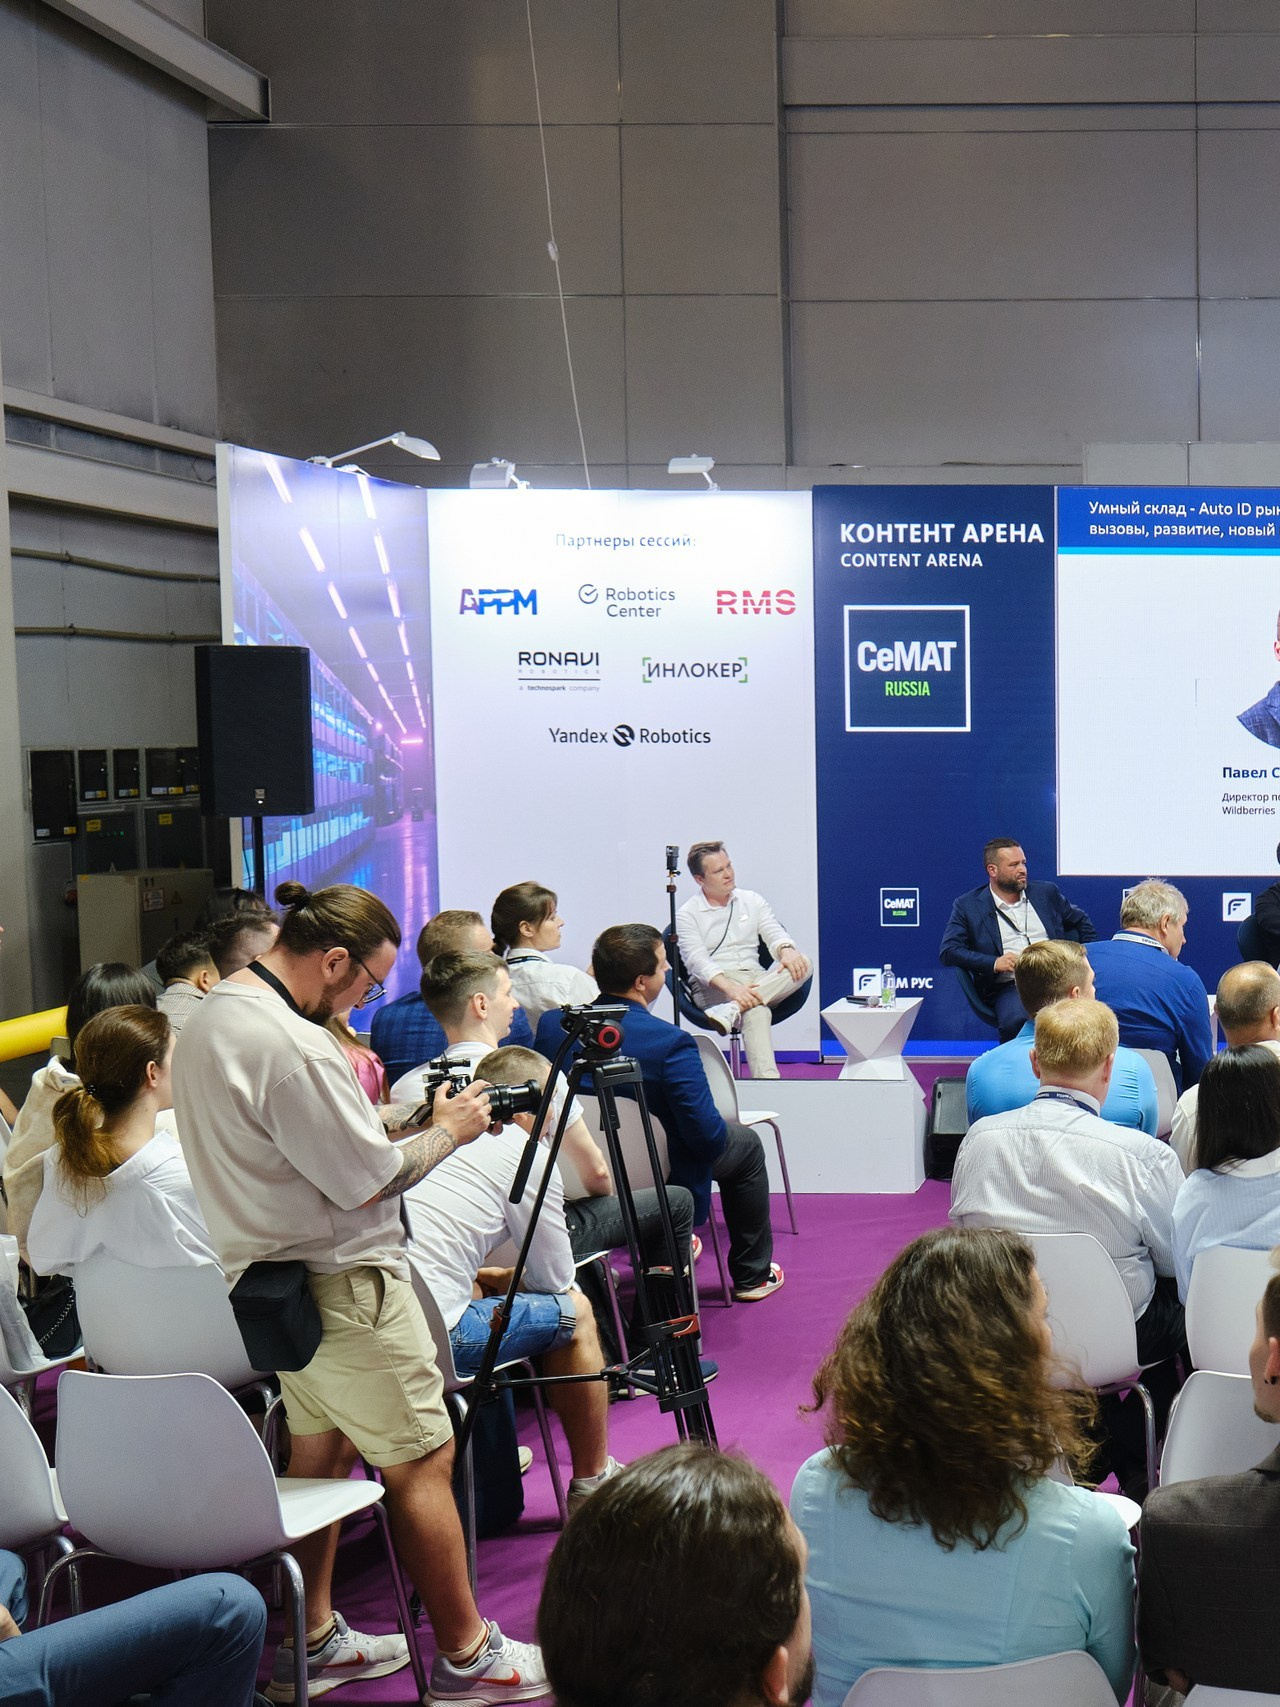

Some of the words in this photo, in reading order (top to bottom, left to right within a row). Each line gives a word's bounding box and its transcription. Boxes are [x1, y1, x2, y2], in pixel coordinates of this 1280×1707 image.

[1089, 501, 1140, 516] Умный
[1144, 503, 1187, 517] склад
[1199, 502, 1233, 515] Auto
[1237, 502, 1251, 516] ID
[840, 523, 956, 543] КОНТЕНТ
[962, 523, 1045, 543] АРЕНА
[1089, 524, 1150, 538] вызовы,
[1154, 524, 1224, 539] развитие,
[1228, 522, 1275, 537] новый
[556, 534, 635, 550] Партнеры
[640, 534, 697, 547] сессий:
[840, 552, 922, 567] CONTENT
[926, 552, 983, 567] ARENA
[606, 587, 676, 601] Robotics
[716, 589, 796, 615] RMS
[606, 604, 662, 617] Center
[518, 652, 600, 666] RONAVI
[857, 640, 957, 672] CeMAT
[648, 663, 743, 678] ИНЛОКЕР
[885, 681, 930, 696] RUSSIA
[549, 728, 608, 743] Yandex
[640, 728, 711, 743] Robotics
[1222, 767, 1267, 778] Павел
[1222, 793, 1269, 803] Директор
[1222, 806, 1276, 814] Wildberries
[884, 899, 915, 909] CeMAT
[911, 978, 933, 988] РУС
